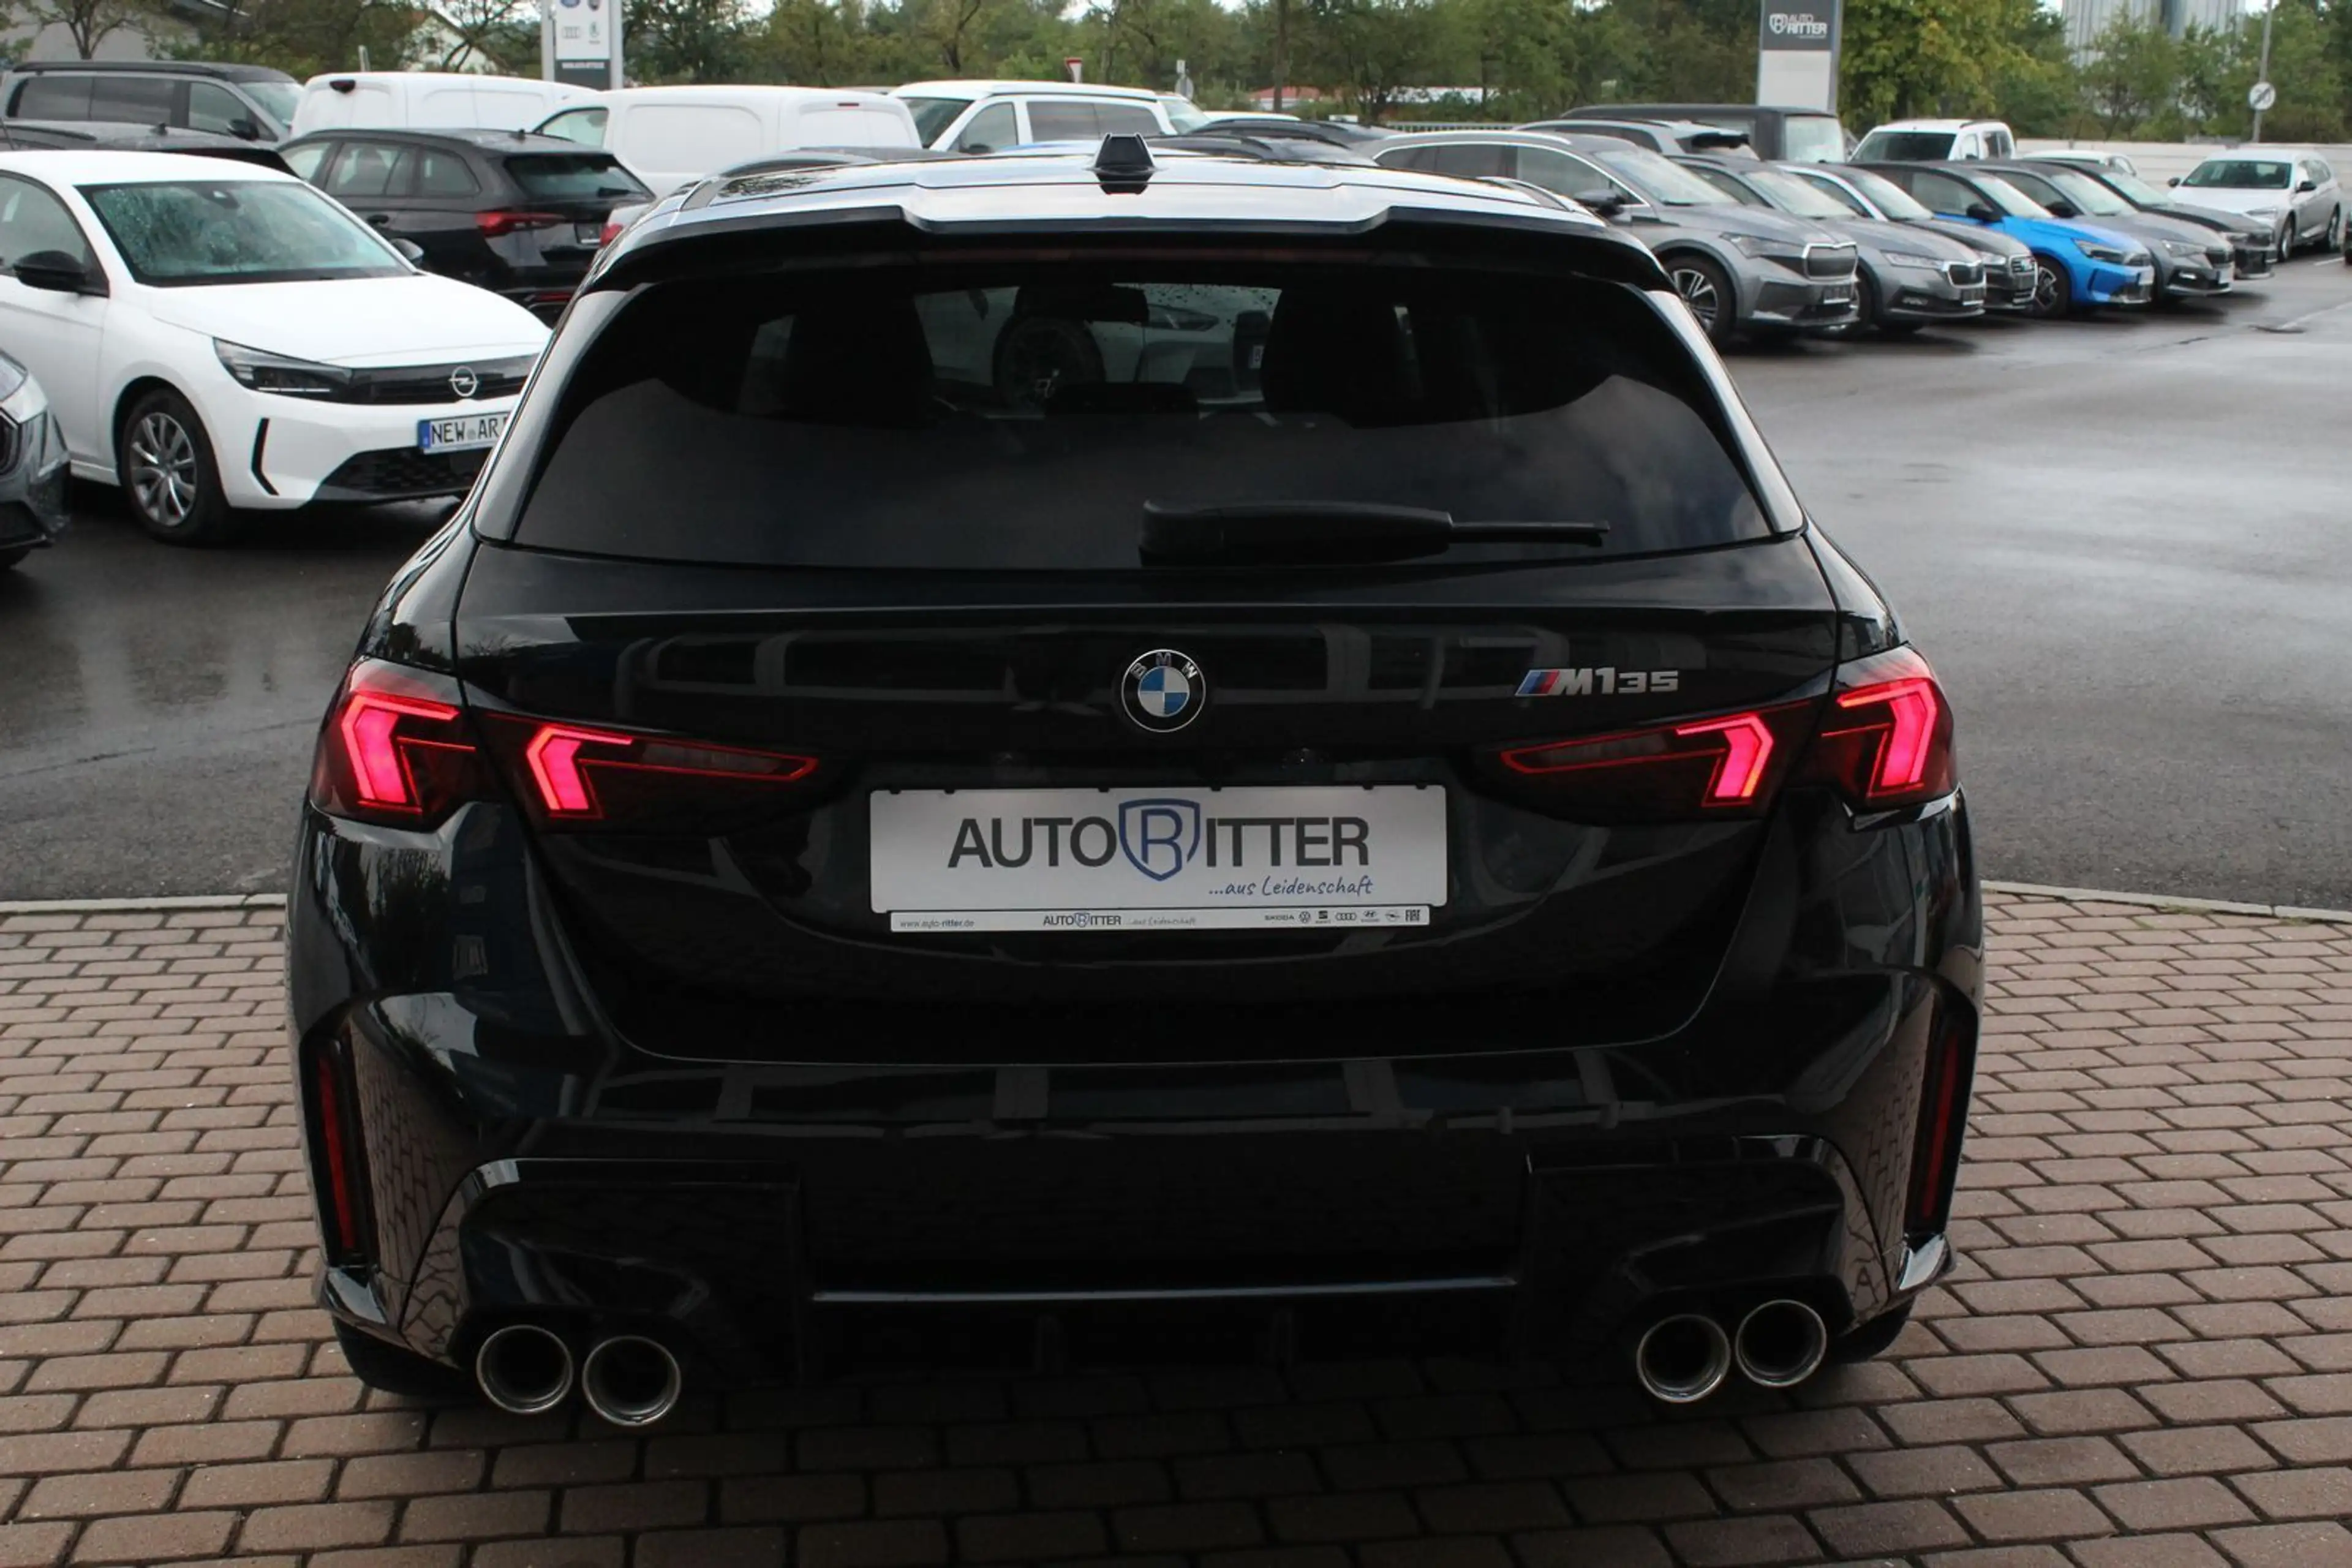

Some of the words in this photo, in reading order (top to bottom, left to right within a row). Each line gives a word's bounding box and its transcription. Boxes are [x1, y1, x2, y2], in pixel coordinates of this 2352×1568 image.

[1787, 22, 1827, 34] RITTER
[1789, 13, 1814, 23] AUTO
[431, 421, 466, 445] NEW
[1129, 652, 1199, 680] BMW
[1547, 667, 1678, 696] M135
[1262, 875, 1373, 897] Leidenschaft
